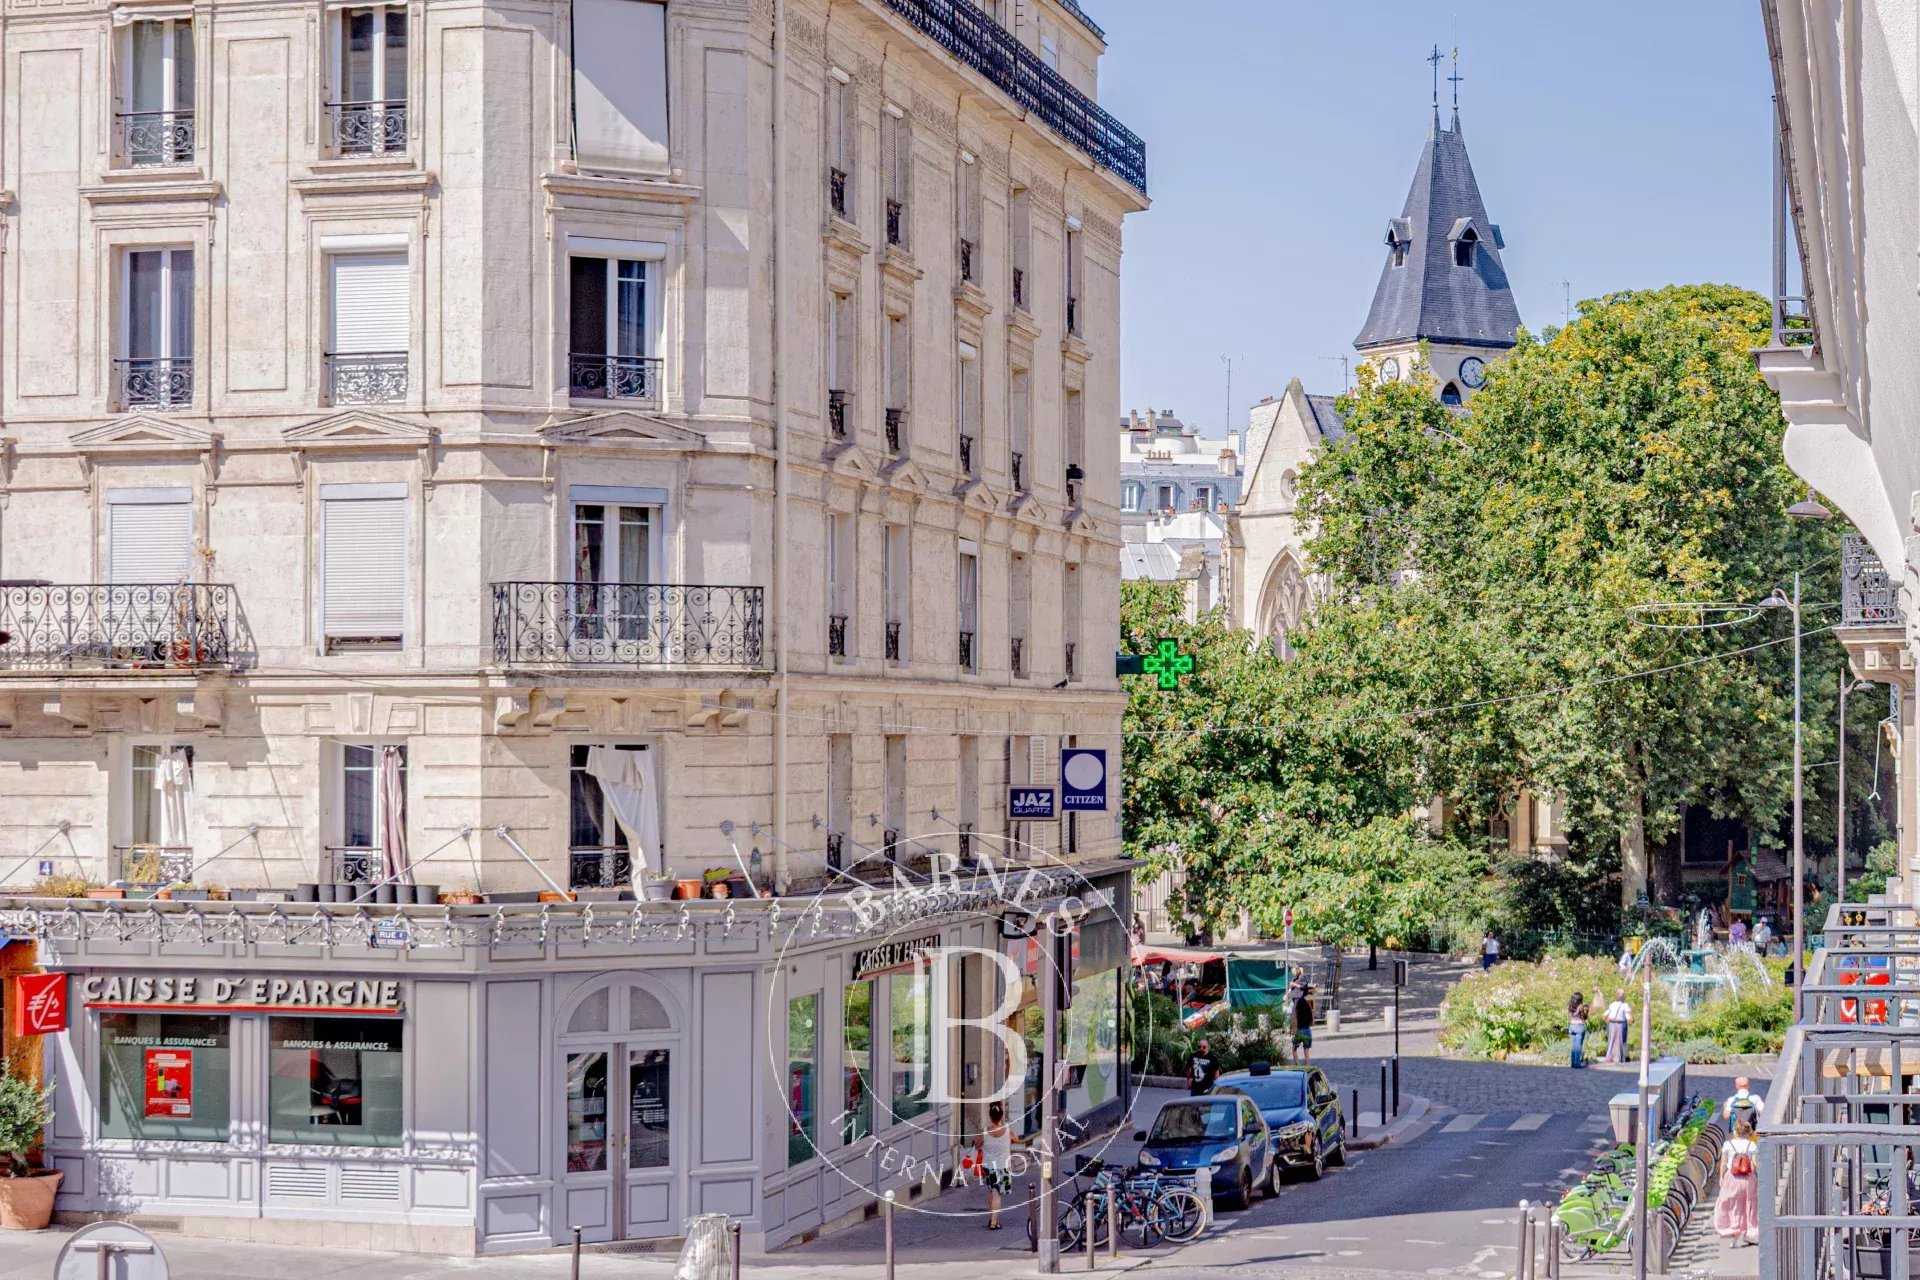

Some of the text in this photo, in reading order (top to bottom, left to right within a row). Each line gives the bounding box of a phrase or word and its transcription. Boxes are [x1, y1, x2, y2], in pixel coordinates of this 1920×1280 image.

[1013, 792, 1051, 807] JAZ
[1064, 795, 1104, 805] CITIZEN
[1013, 806, 1051, 814] QUARTZ
[43, 861, 50, 875] 4
[860, 944, 891, 972] CAISSE
[83, 976, 196, 1001] CAISSE
[113, 1036, 217, 1047] BANQUES & ASSURANCES
[283, 1040, 389, 1051] BANQUES & ASSURANCES
